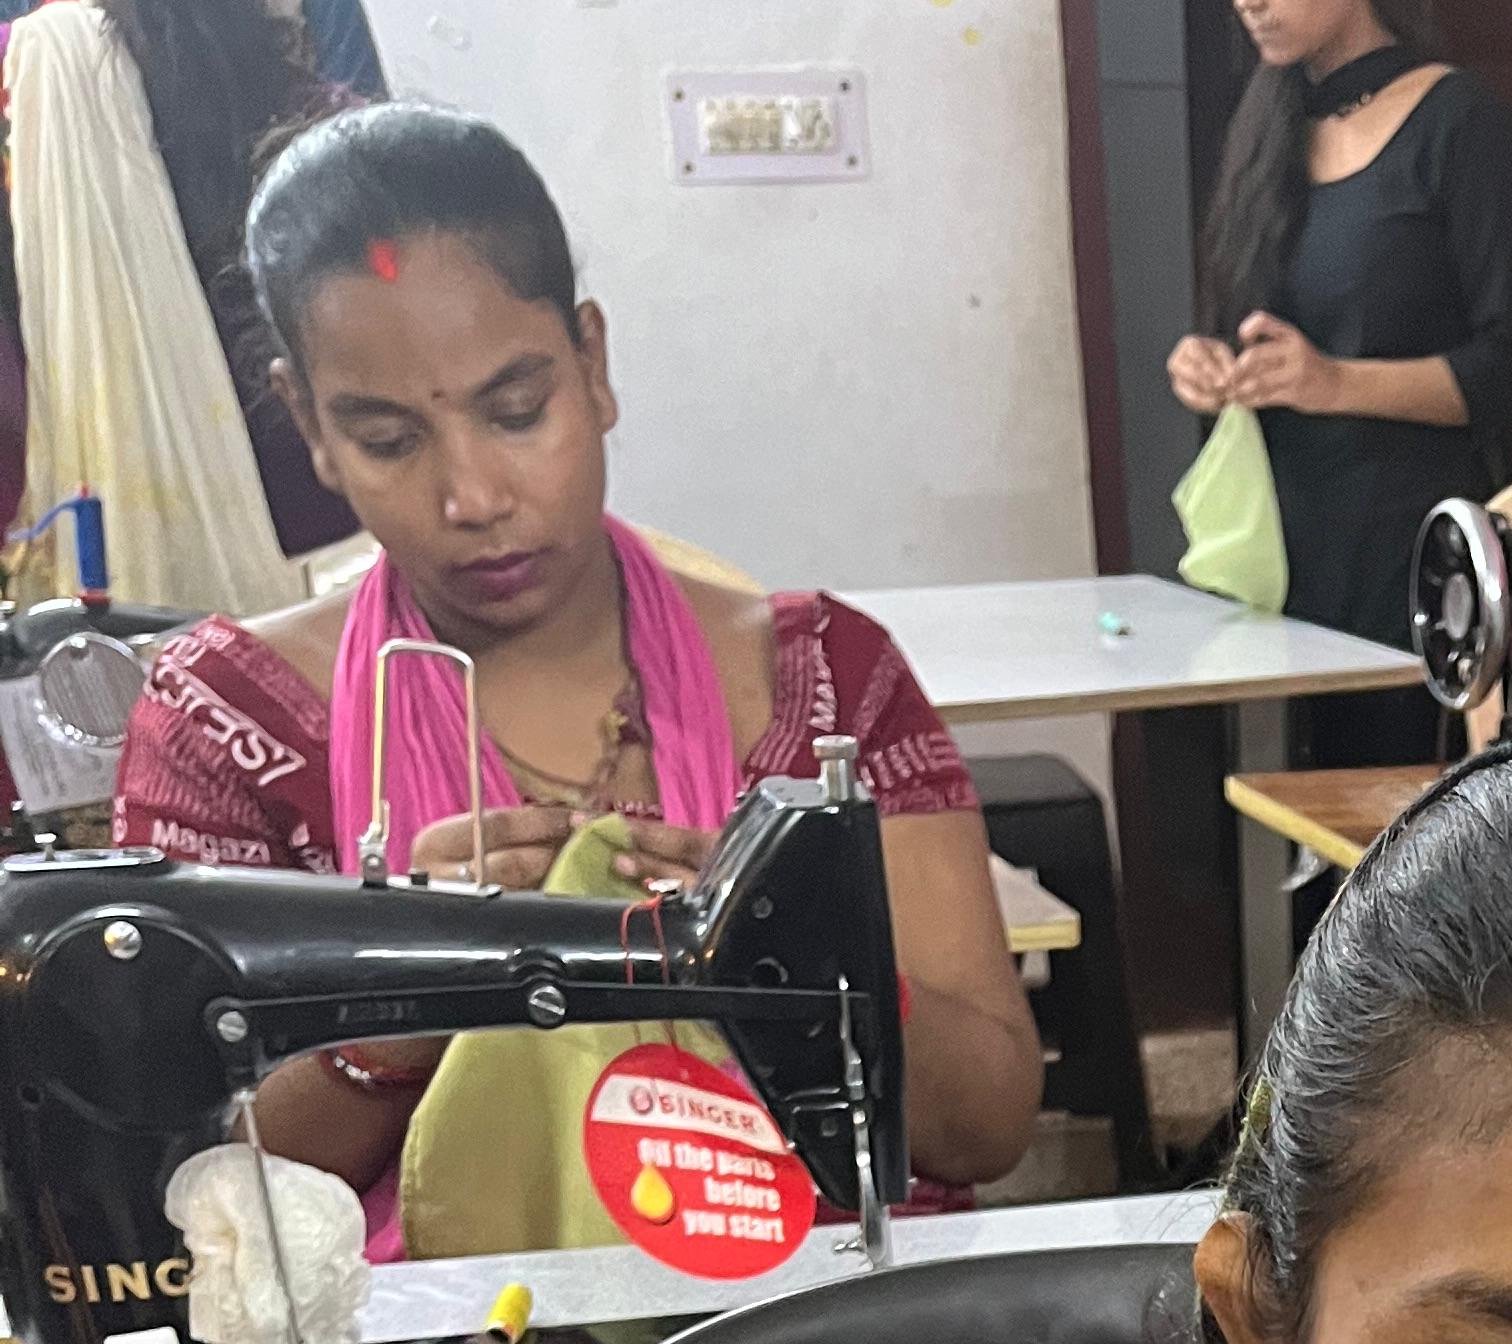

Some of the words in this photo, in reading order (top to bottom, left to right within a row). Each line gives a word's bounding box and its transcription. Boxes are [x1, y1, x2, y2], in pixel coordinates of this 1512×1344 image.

[658, 1093, 758, 1134] SINGER
[674, 1141, 712, 1172] the
[716, 1151, 776, 1181] parts
[704, 1175, 781, 1212] before
[682, 1209, 727, 1236] you
[729, 1213, 785, 1243] start
[44, 1257, 192, 1303] SING
